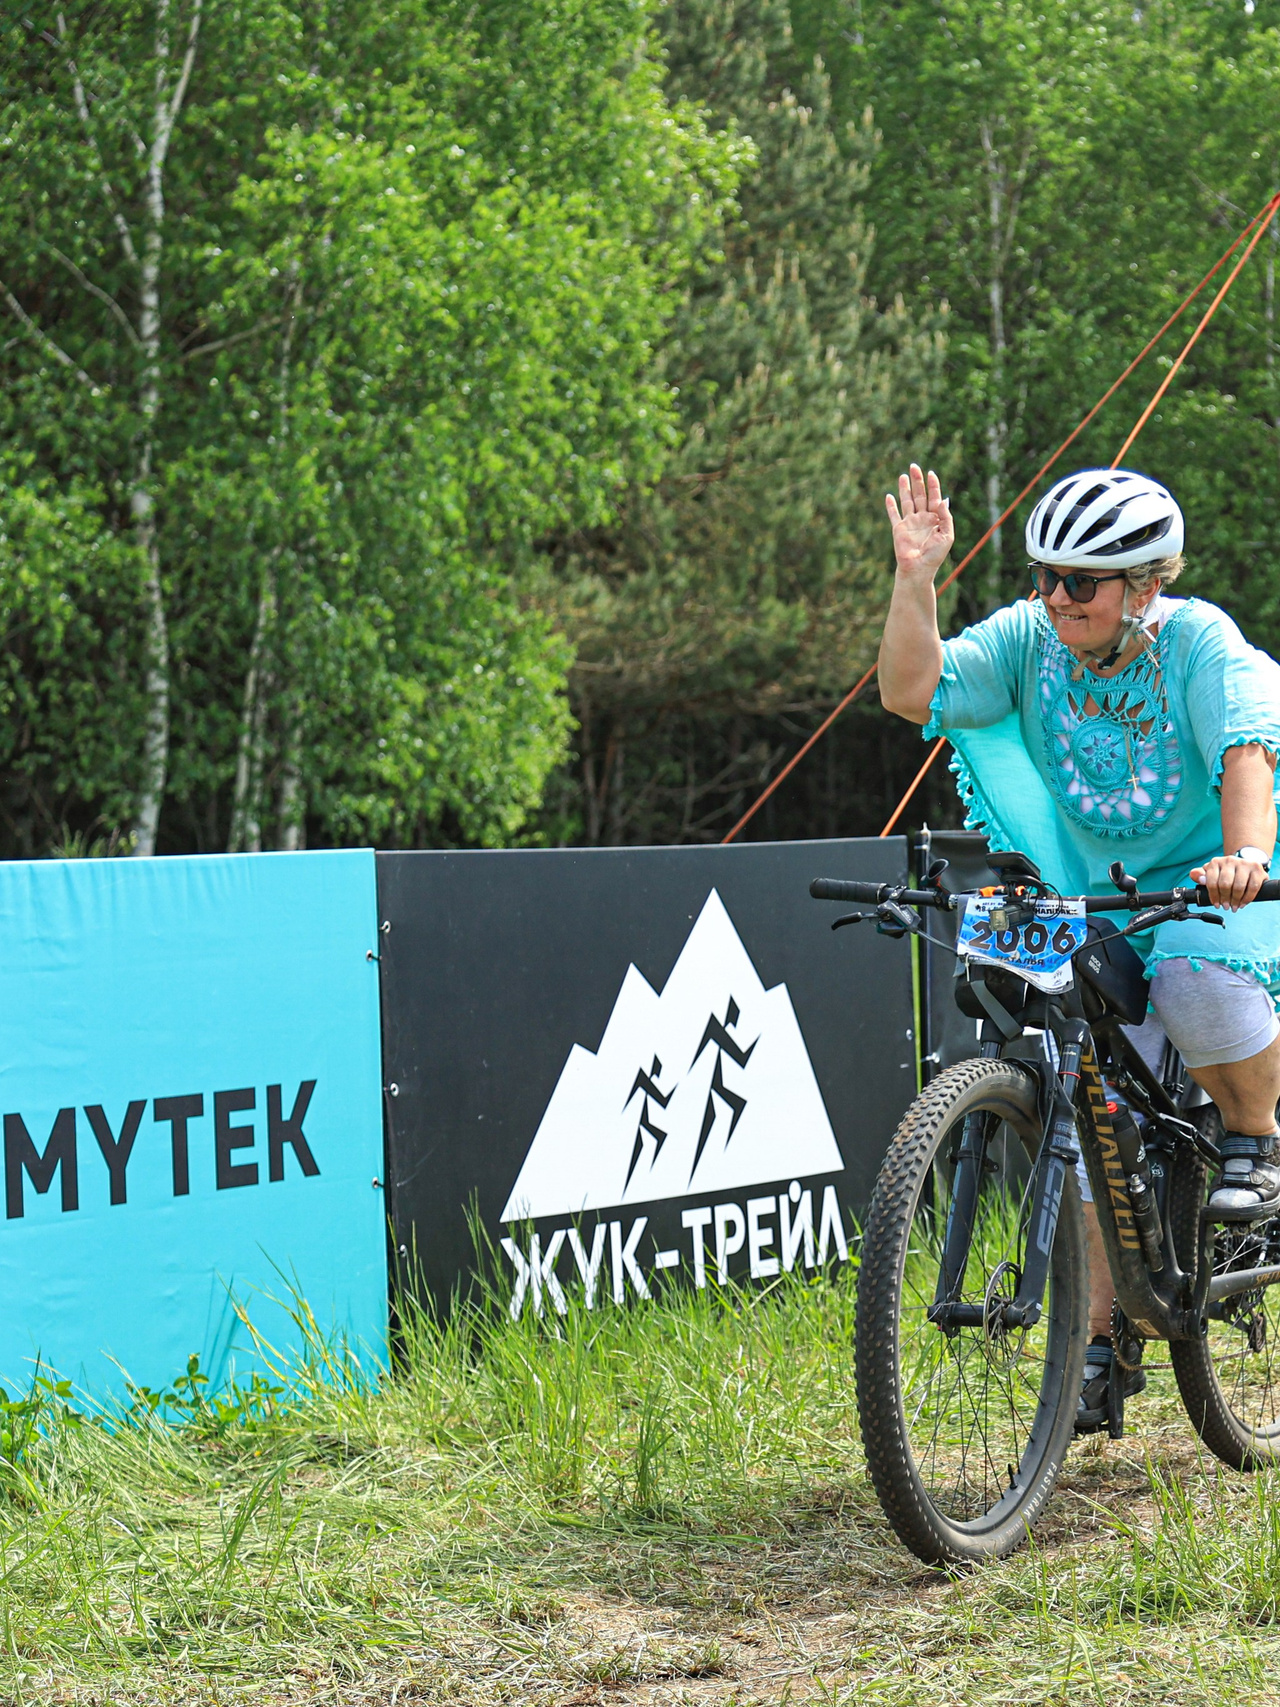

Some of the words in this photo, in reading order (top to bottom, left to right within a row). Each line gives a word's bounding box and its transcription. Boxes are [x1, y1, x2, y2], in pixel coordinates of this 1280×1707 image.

[968, 920, 1077, 956] 2006
[499, 1180, 850, 1323] ЖУК-ТРЕЙЛ
[1041, 1461, 1058, 1493] FAST
[1023, 1492, 1044, 1520] TRAK
